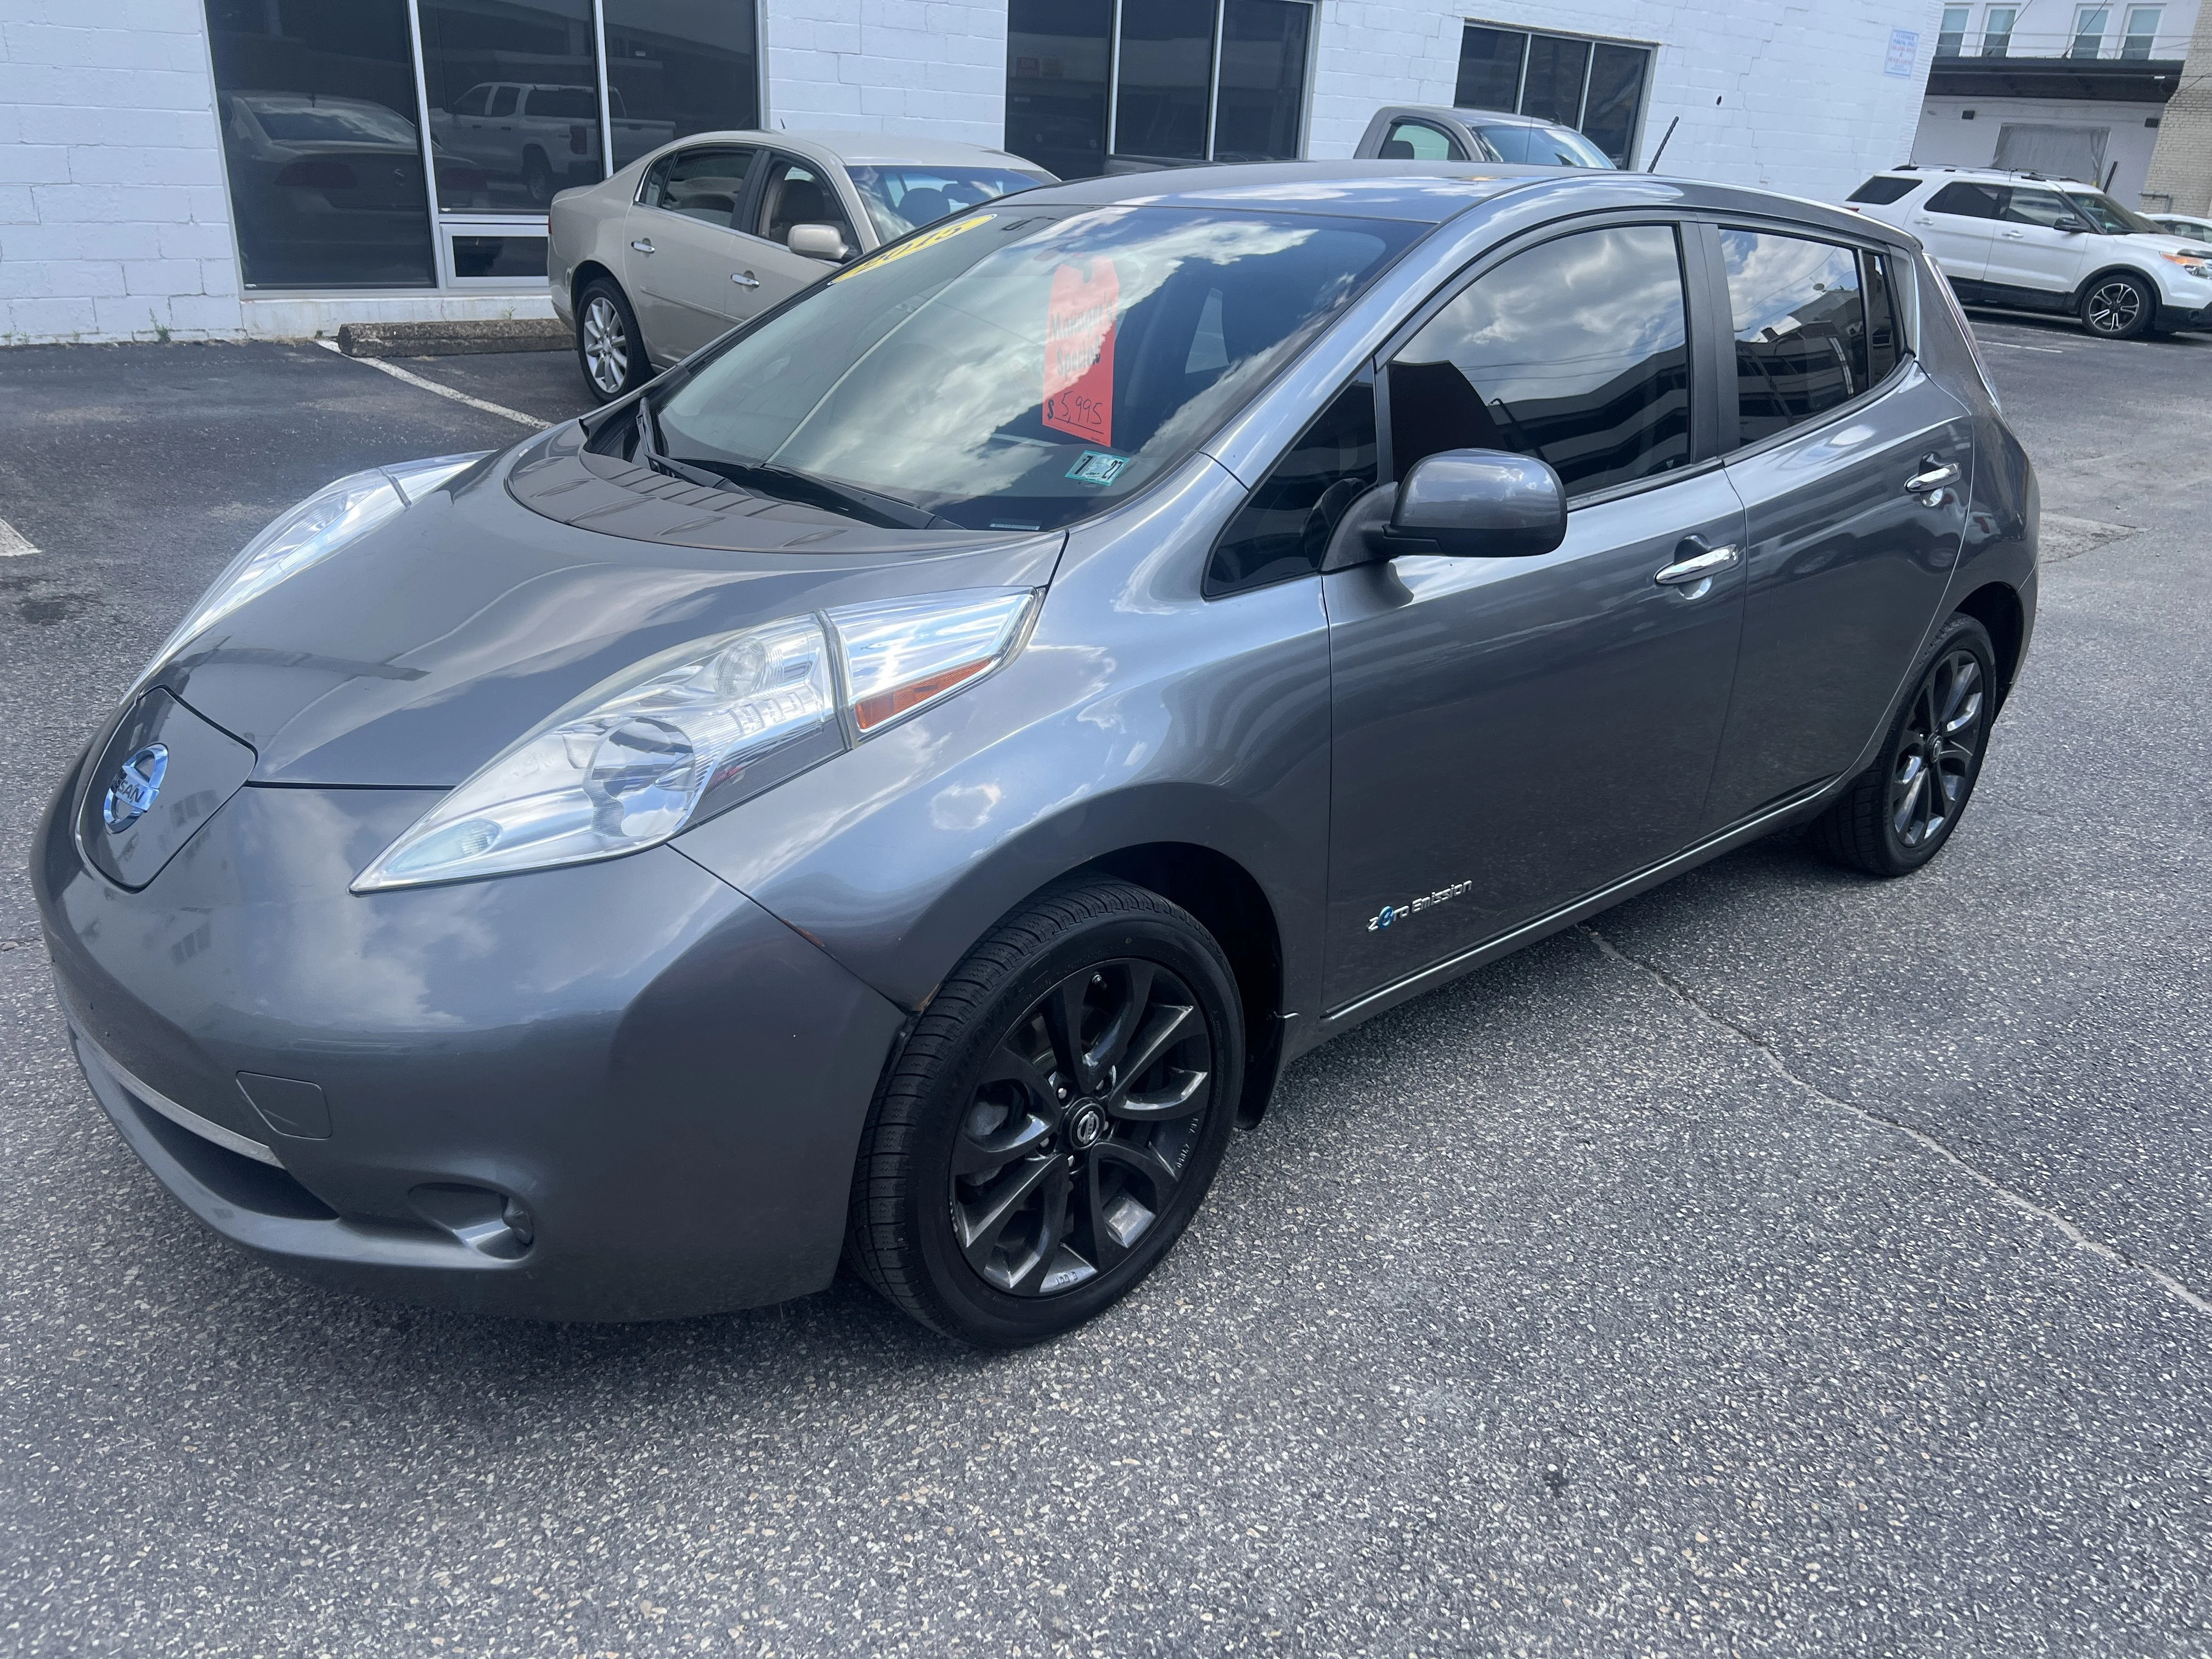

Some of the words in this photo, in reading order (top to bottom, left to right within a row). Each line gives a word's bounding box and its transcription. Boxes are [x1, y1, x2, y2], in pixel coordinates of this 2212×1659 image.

[1052, 291, 1114, 341] Manager's
[1057, 334, 1101, 379] Special
[1074, 455, 1094, 475] 7
[1412, 880, 1472, 913] Emission
